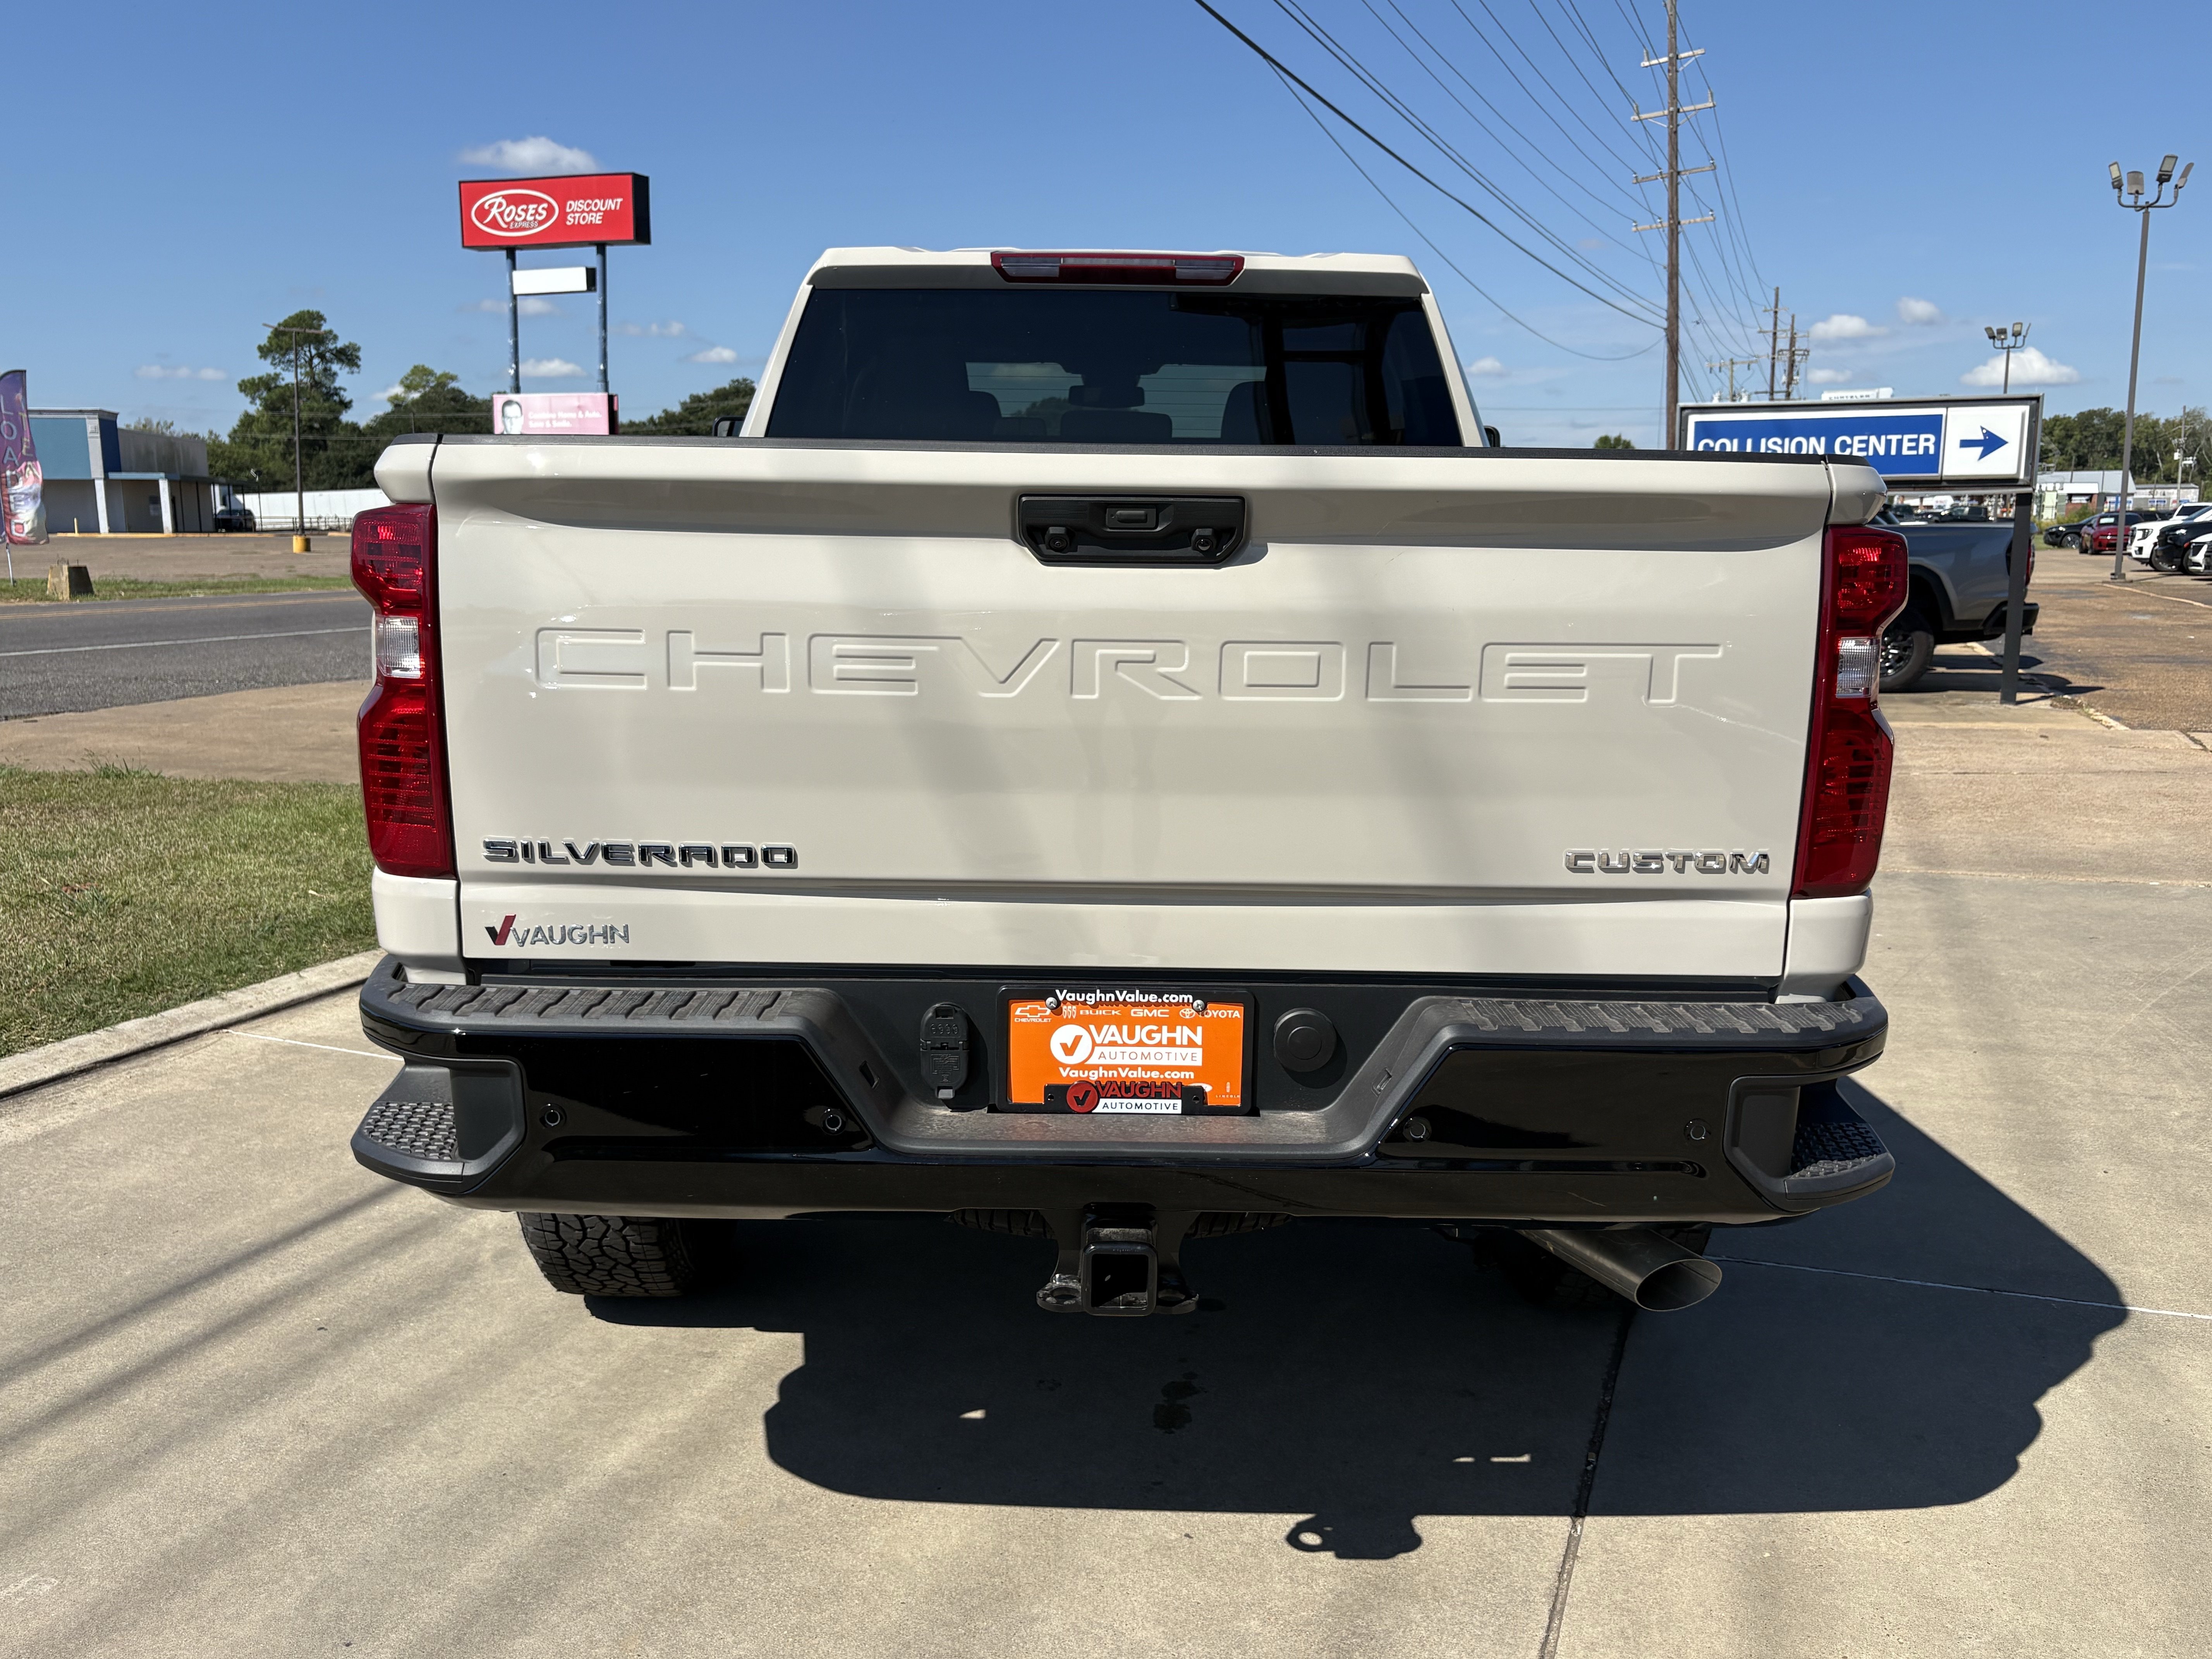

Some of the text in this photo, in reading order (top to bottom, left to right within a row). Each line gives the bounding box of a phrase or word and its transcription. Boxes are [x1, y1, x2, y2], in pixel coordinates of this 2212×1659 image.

[566, 198, 623, 212] DISCOUNT
[509, 220, 539, 229] EXPRESS
[566, 213, 603, 225] STORE
[1834, 434, 1936, 456] CENTER
[535, 627, 1722, 705] CHEVROLET
[482, 838, 798, 867] SILVERADO
[1565, 851, 1769, 871] CUSTOM
[1055, 989, 1193, 1005] VaughnValue.com
[1130, 1009, 1170, 1017] GMC
[1088, 1024, 1203, 1046] VAUGHN
[1098, 1051, 1198, 1061] AUTOMOTIVE
[1059, 1066, 1194, 1080] VaughnValue.com
[1094, 1081, 1182, 1098] VAUGHN
[1102, 1102, 1178, 1110] AUTOMOTIVE
